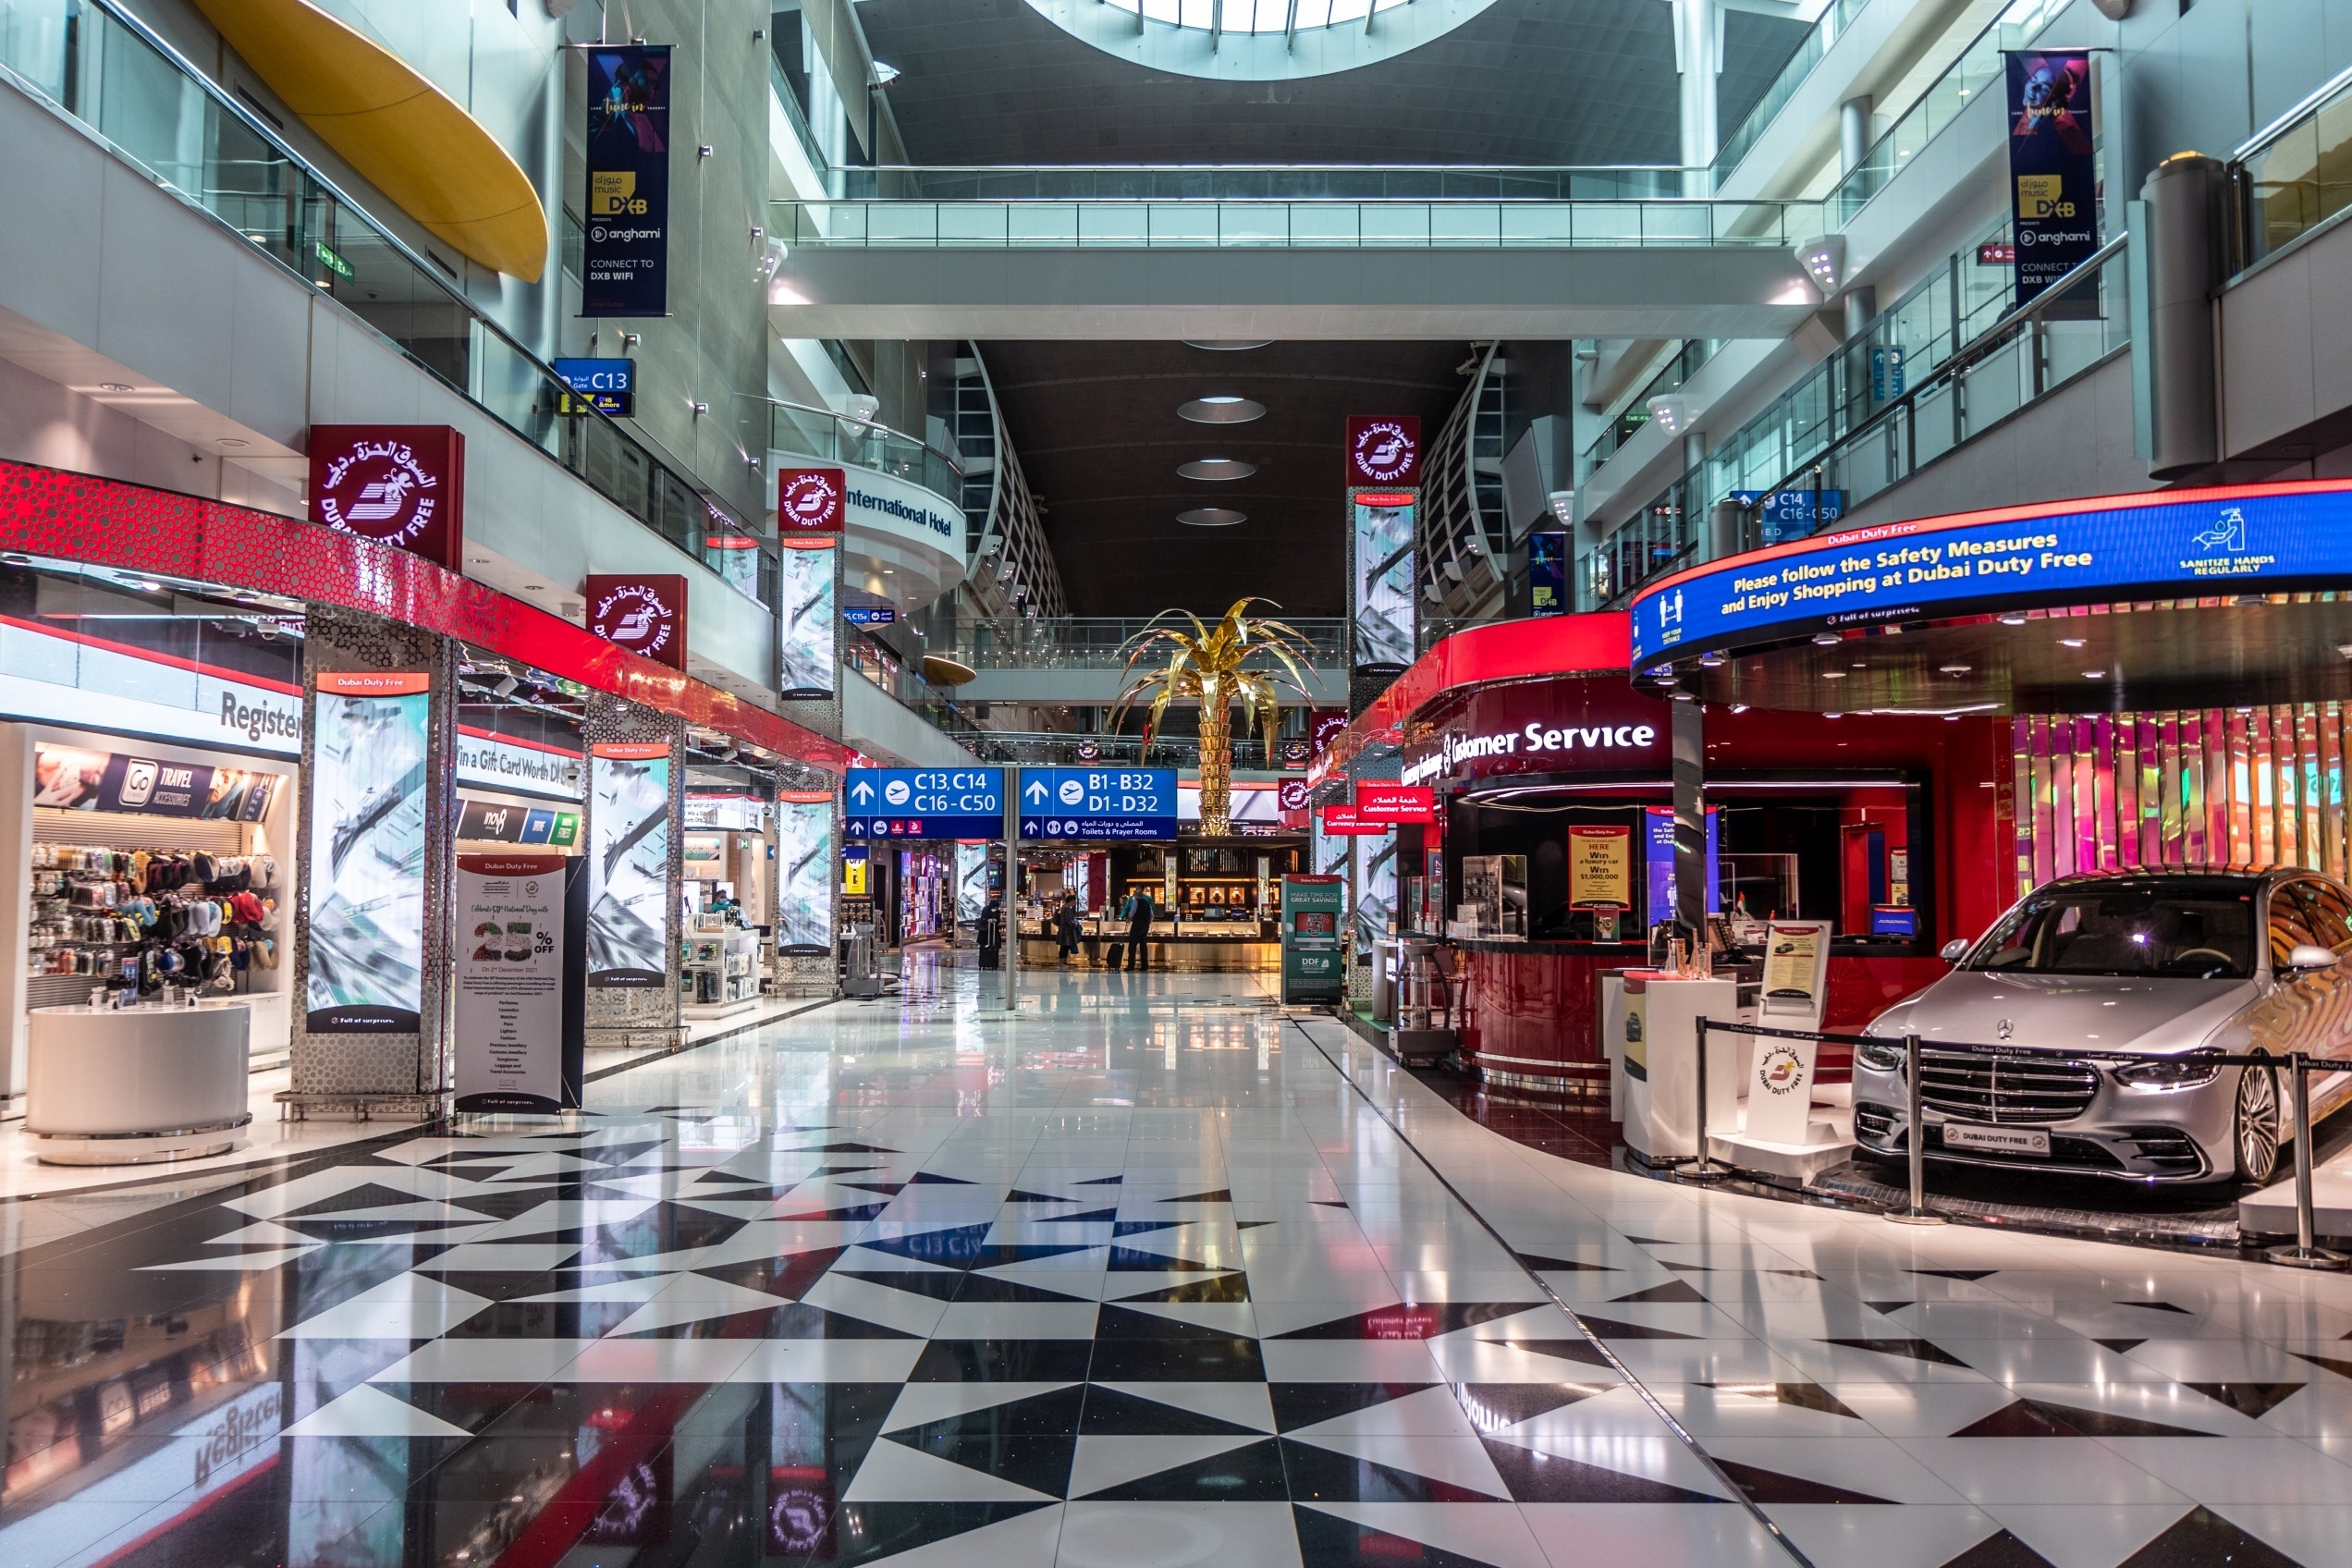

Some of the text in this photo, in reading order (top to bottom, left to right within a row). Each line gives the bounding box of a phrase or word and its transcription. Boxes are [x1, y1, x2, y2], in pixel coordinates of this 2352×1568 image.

[609, 196, 648, 215] DXB
[2036, 200, 2076, 218] DXB
[609, 228, 661, 242] anghami
[2038, 230, 2090, 245] anghami
[591, 260, 654, 268] CONNECT TO
[2021, 263, 2069, 272] CONNECT
[2022, 276, 2042, 284] DXB
[592, 373, 627, 389] C13
[1355, 452, 1414, 480] DUBAI DUTY FREE
[1779, 493, 1806, 507] C14,
[405, 497, 435, 537] FREE
[784, 500, 836, 526] DUBAI DUTY FREE
[845, 485, 951, 537] International Hotel
[1827, 523, 1917, 545] Dubai Duty Free
[1734, 533, 2058, 594] Please follow the Safety Measures
[2179, 555, 2275, 568] SANITIZE HANDS
[2194, 564, 2260, 576] REGULARLY
[1721, 552, 2093, 615] and Enjoy Shopping at Dubai Duty Free
[1859, 611, 1869, 619] of
[651, 624, 671, 651] FREE
[337, 678, 362, 686] Dubai
[364, 678, 384, 687] Duty
[1452, 732, 1519, 764] Customer
[1525, 723, 1655, 752] Service
[457, 744, 548, 781] in a Gift Card Worth
[159, 767, 193, 788] TRAVEL
[152, 791, 191, 807] ACCESSORIES
[472, 921, 553, 962] 25 %
[534, 946, 554, 954] OFF
[1972, 1045, 1994, 1054] Dubai
[1996, 1047, 2014, 1056] Duty
[2321, 1061, 2343, 1069] Duty
[1760, 1070, 1772, 1090] DUBAI
[1792, 1073, 1803, 1090] FREE
[1963, 1133, 1986, 1141] DUBAI
